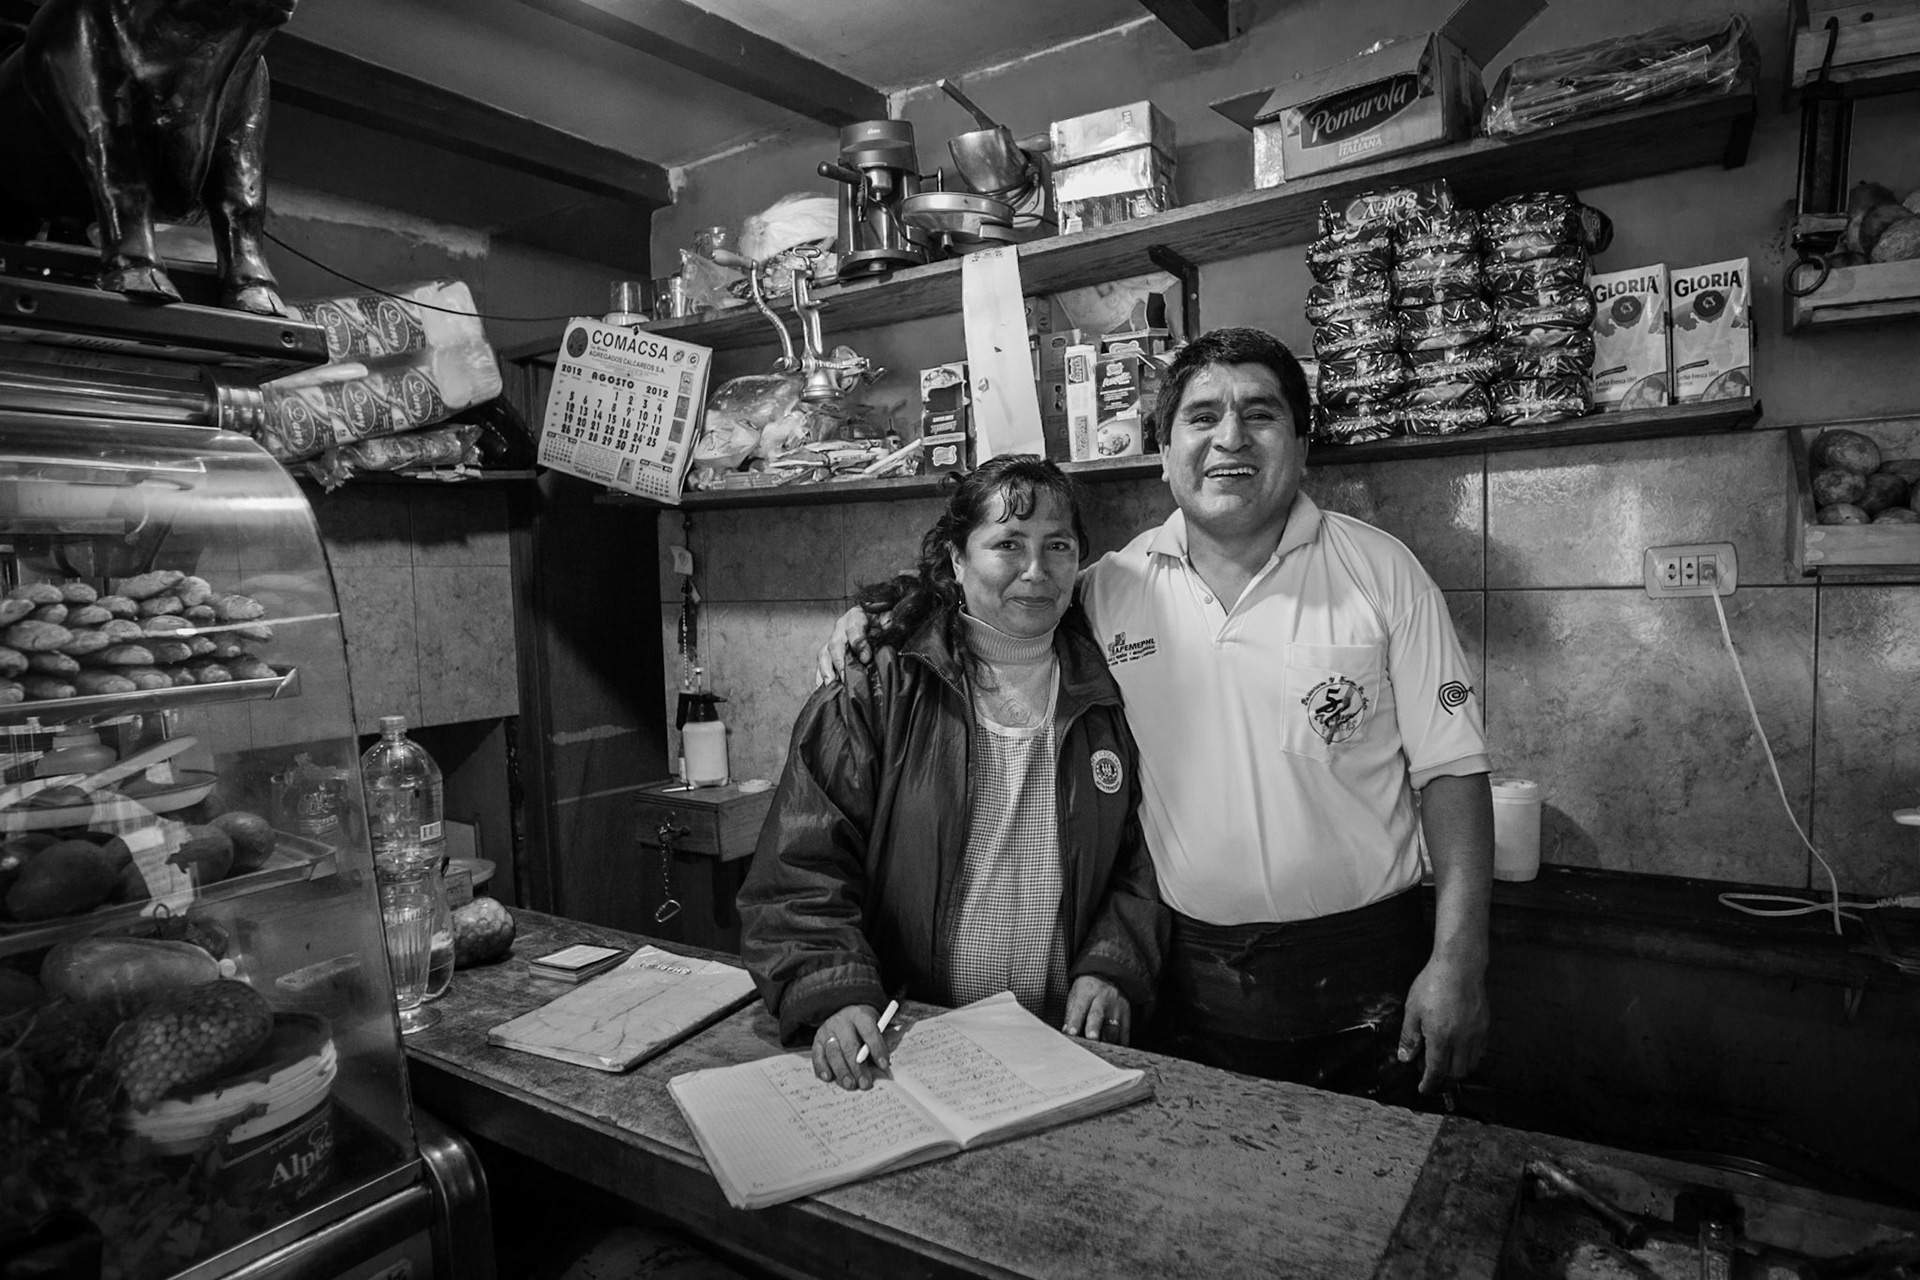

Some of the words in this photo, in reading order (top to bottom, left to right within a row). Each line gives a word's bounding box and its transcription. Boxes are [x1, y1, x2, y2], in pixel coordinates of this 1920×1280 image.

[1310, 78, 1408, 143] Pomarola
[1338, 138, 1382, 156] ITALIANA
[1593, 275, 1659, 303] GLORIA
[1674, 270, 1743, 297] GLORIA
[588, 350, 622, 364] AGREGADOS
[623, 357, 655, 372] CALCAREOS
[592, 330, 668, 361] COMACSA
[561, 364, 582, 376] 2012
[591, 372, 634, 389] AGOSTO
[646, 385, 669, 398] 2012
[564, 412, 573, 423] 19
[576, 416, 587, 427] 20
[590, 420, 600, 432] 21
[604, 424, 615, 436] 22
[619, 428, 629, 439] 23
[646, 436, 657, 448] 25
[566, 401, 575, 413] 12
[579, 405, 588, 416] 13
[593, 409, 602, 420] 14
[607, 413, 617, 424] 15
[622, 417, 631, 428] 16
[650, 425, 660, 436] 18
[639, 410, 648, 421] 10
[653, 414, 662, 425] 11
[561, 423, 571, 435] 26
[574, 427, 585, 438] 27
[588, 431, 598, 443] 28
[601, 435, 612, 446] 29
[615, 439, 626, 451] 30
[629, 443, 639, 455] 31
